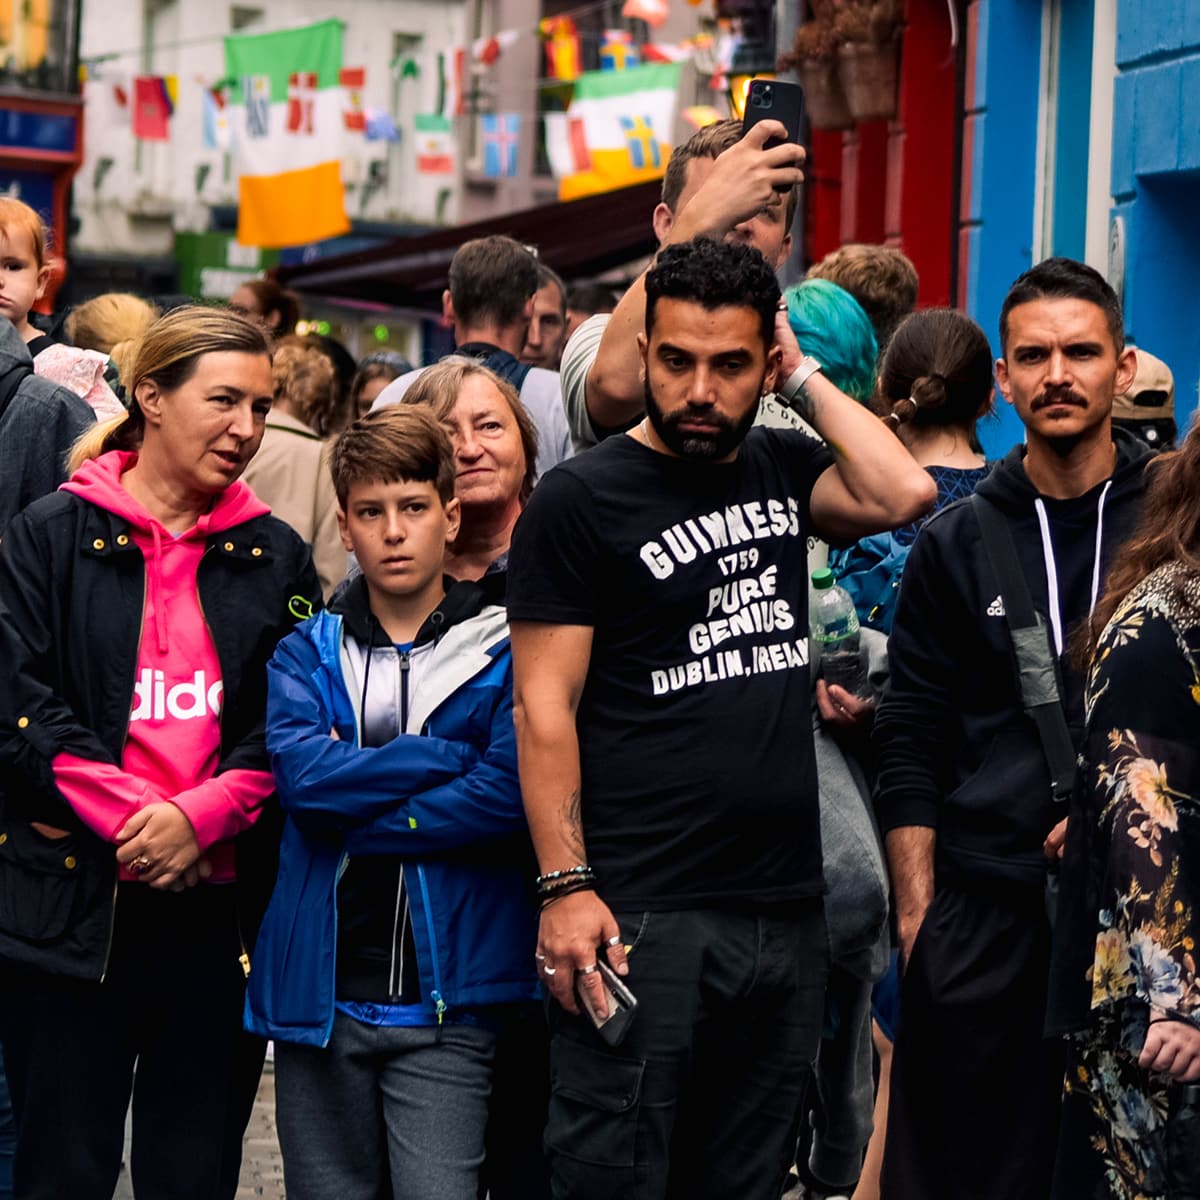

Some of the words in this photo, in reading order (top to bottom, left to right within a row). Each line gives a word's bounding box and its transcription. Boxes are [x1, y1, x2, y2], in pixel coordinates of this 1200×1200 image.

[639, 497, 799, 580] GUINNESS
[718, 547, 759, 576] 1759
[706, 564, 778, 618] PURE
[688, 599, 795, 655] GENIUS
